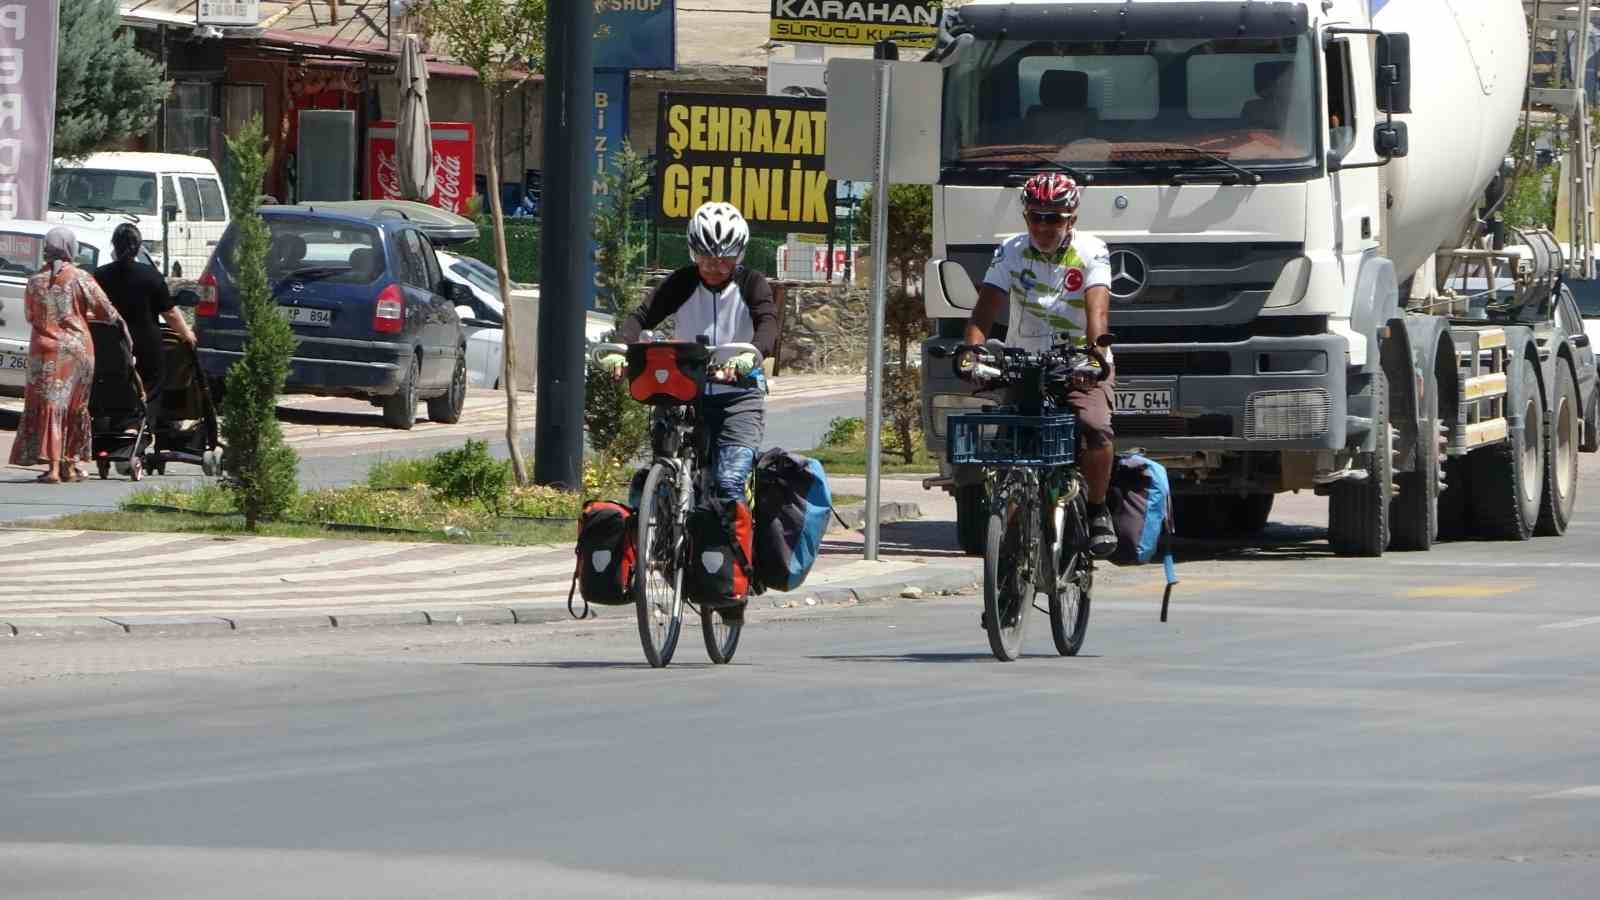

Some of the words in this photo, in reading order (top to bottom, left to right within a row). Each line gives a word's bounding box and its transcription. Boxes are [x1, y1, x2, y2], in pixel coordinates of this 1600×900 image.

[776, 0, 937, 25] KARAHAN
[777, 22, 860, 40] SÜRÜCÜ
[668, 104, 827, 159] ŞEHRAZAT
[662, 157, 829, 223] GELİNLİK
[1114, 392, 1137, 409] YZ
[1143, 391, 1169, 409] 644
